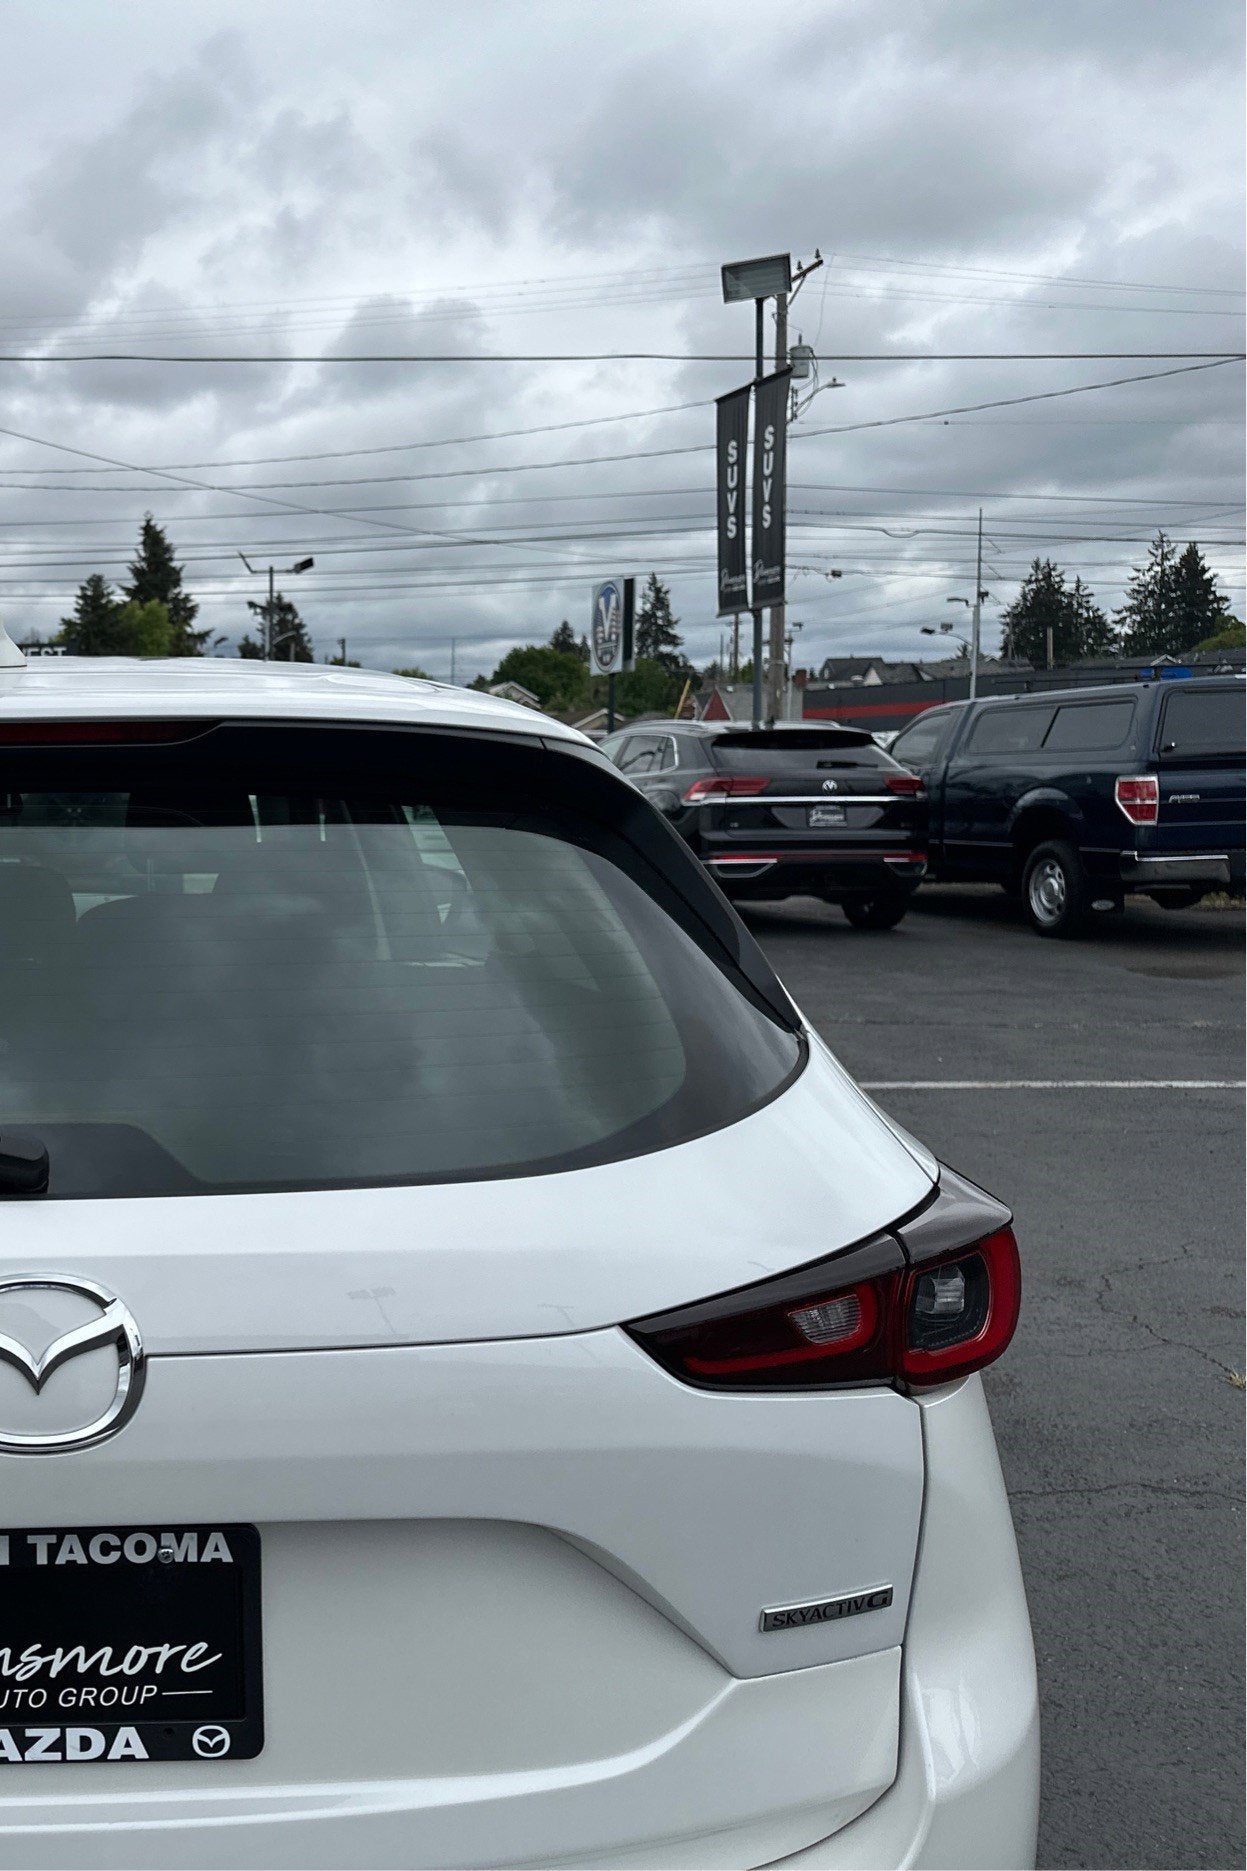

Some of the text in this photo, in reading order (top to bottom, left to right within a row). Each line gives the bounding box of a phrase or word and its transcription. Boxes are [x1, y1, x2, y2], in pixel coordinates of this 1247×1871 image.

[727, 439, 738, 539] SUVS
[762, 425, 775, 529] SUVS
[27, 1532, 234, 1565] TACOMA
[58, 1685, 158, 1708] GROUP
